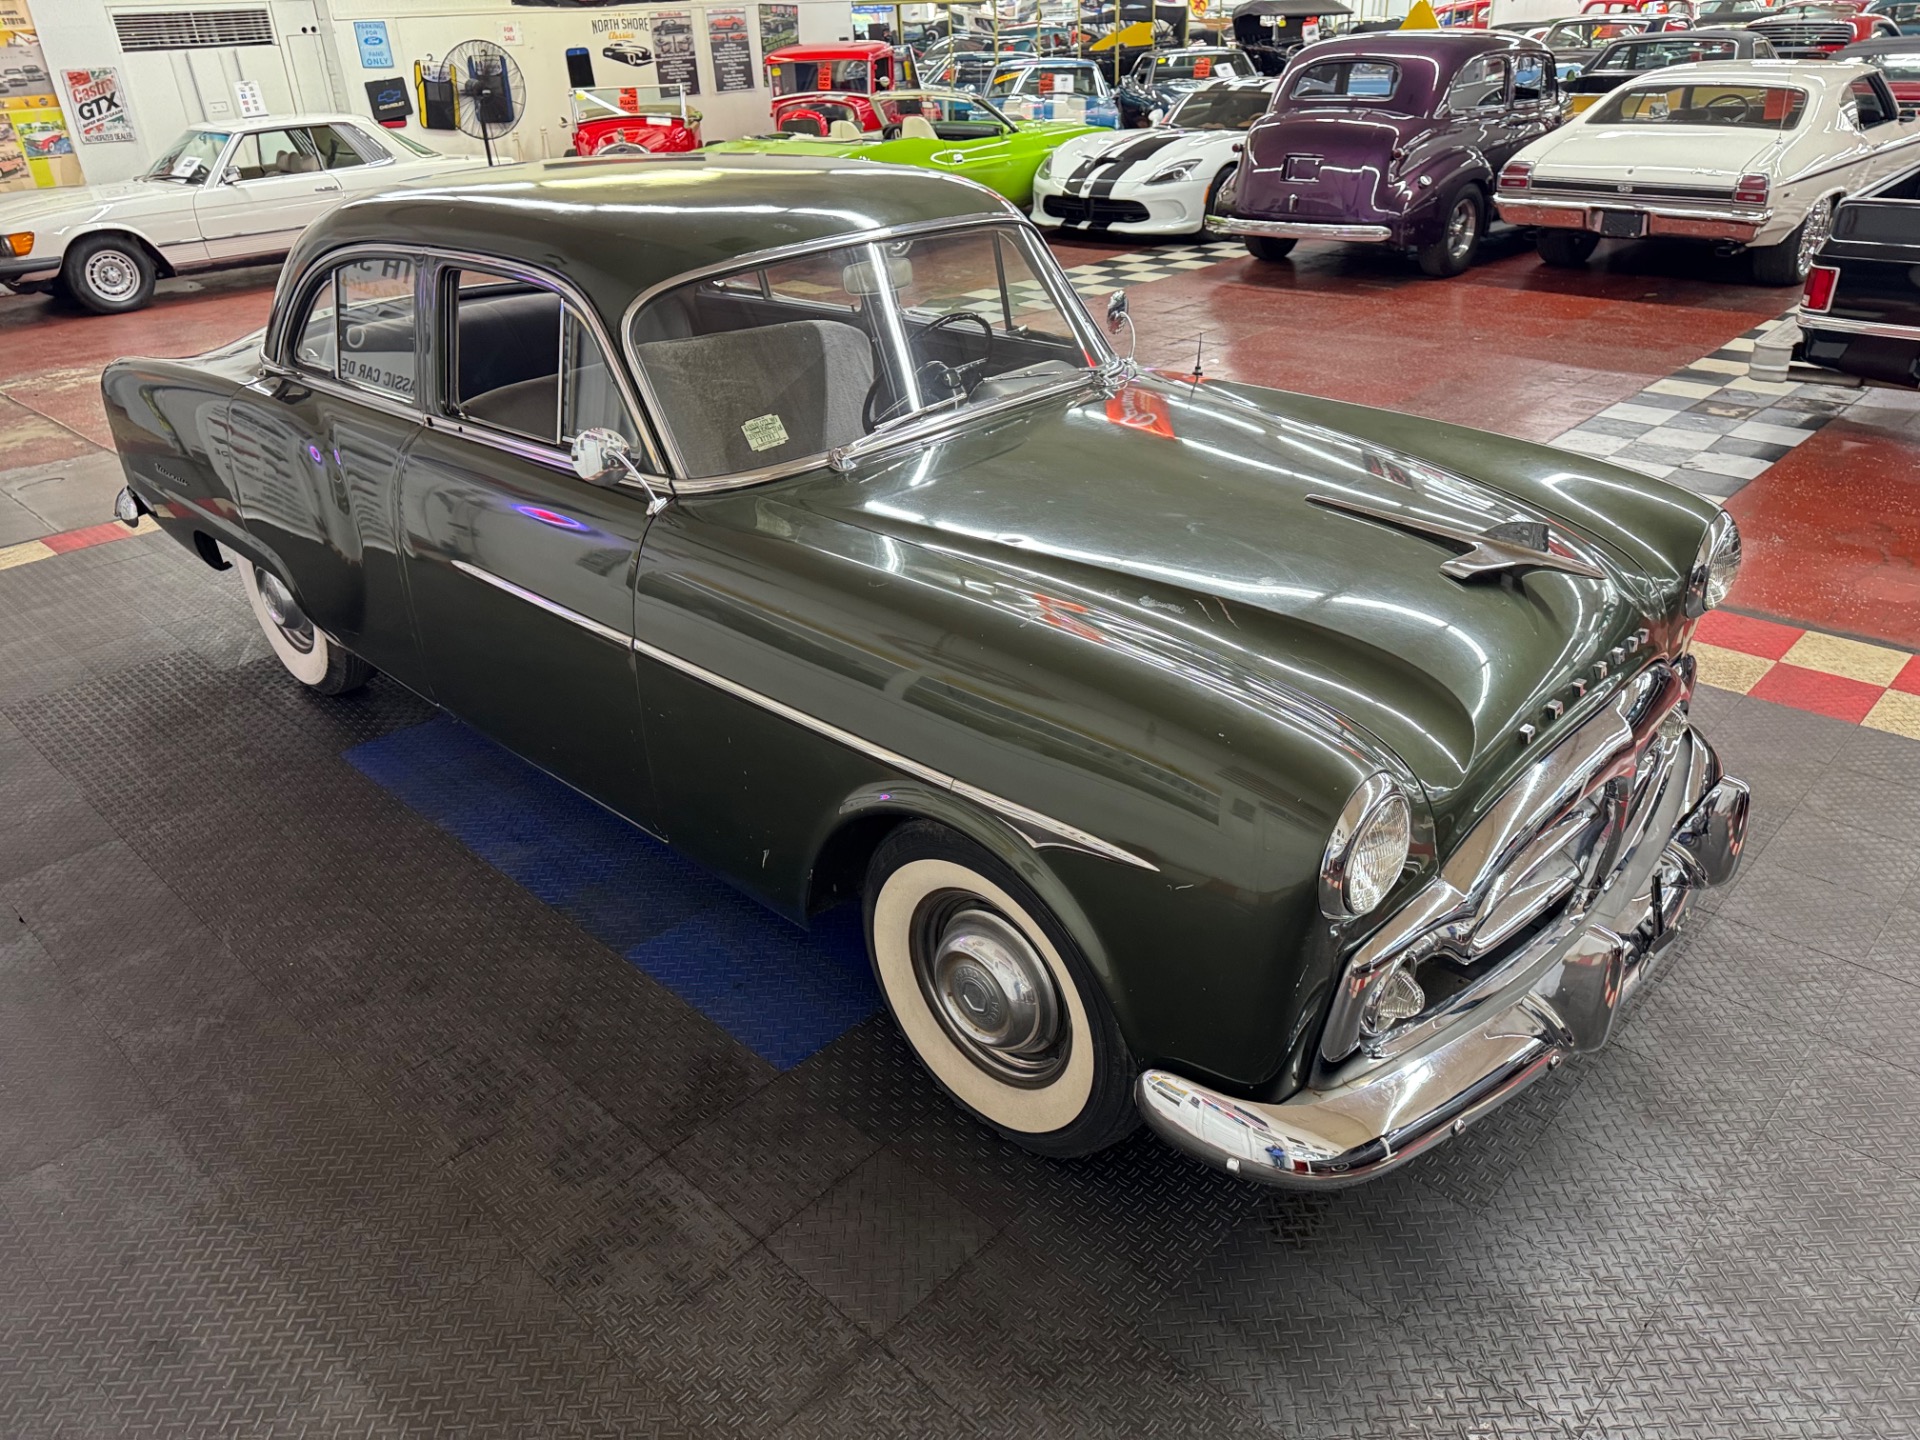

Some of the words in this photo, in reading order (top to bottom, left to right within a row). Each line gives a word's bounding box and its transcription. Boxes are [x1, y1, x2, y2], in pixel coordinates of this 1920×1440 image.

[591, 18, 620, 34] NORTH
[621, 17, 649, 31] SHORE
[366, 57, 389, 65] ONLY
[73, 77, 116, 104] Castrol
[79, 91, 121, 121] GTX
[82, 120, 96, 128] SUPER
[114, 132, 134, 141] DEALER
